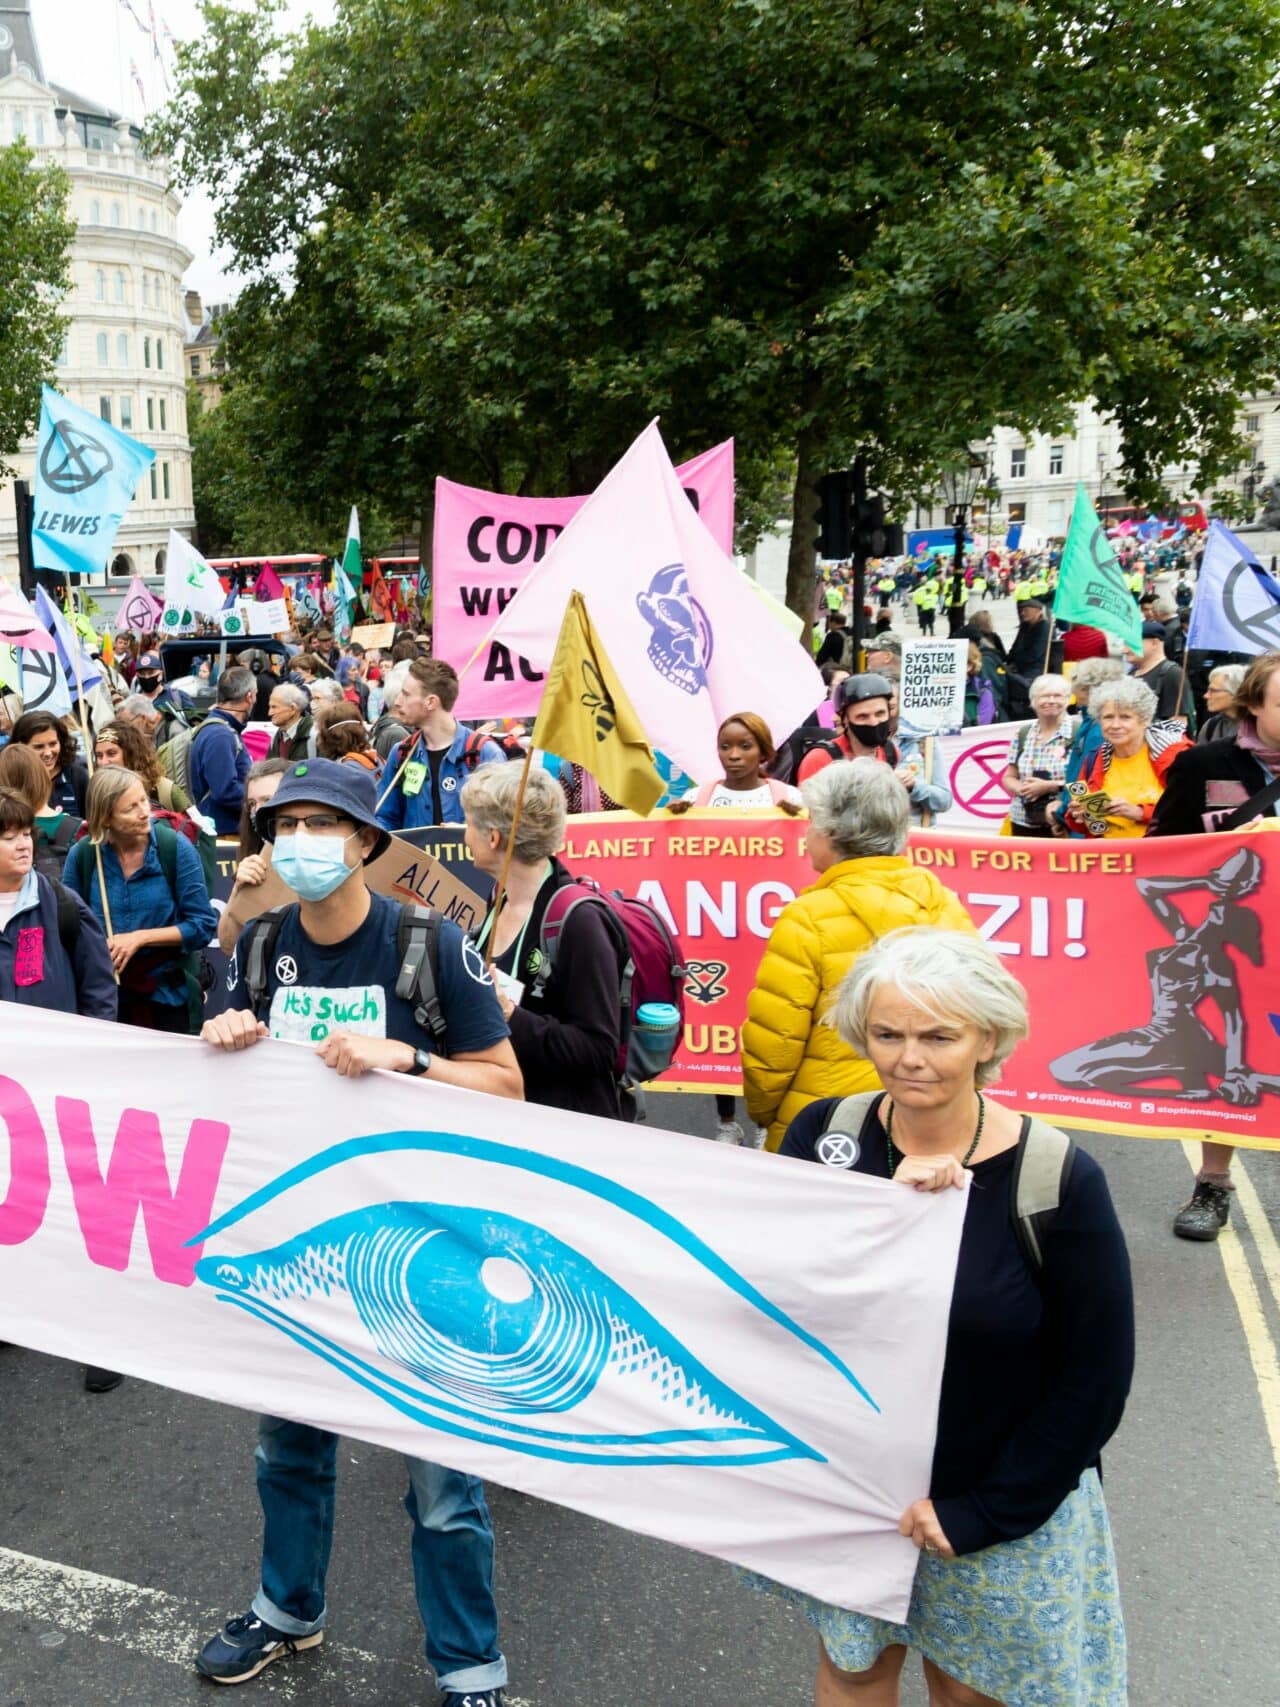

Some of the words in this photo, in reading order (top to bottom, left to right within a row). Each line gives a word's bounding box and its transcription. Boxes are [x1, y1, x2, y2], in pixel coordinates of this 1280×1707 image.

[37, 511, 102, 536] LEWES
[905, 652, 955, 664] SYSTEM
[904, 664, 957, 675] CHANGE
[904, 675, 931, 686] NOT
[903, 686, 956, 697] CLIMATE
[903, 697, 955, 709] CHANGE
[668, 836, 784, 857] REPAIRS
[970, 850, 1032, 872] FOR
[1049, 852, 1135, 874] LIFE!
[395, 862, 442, 907] ALL
[283, 988, 312, 1017] It's
[315, 989, 379, 1023] such
